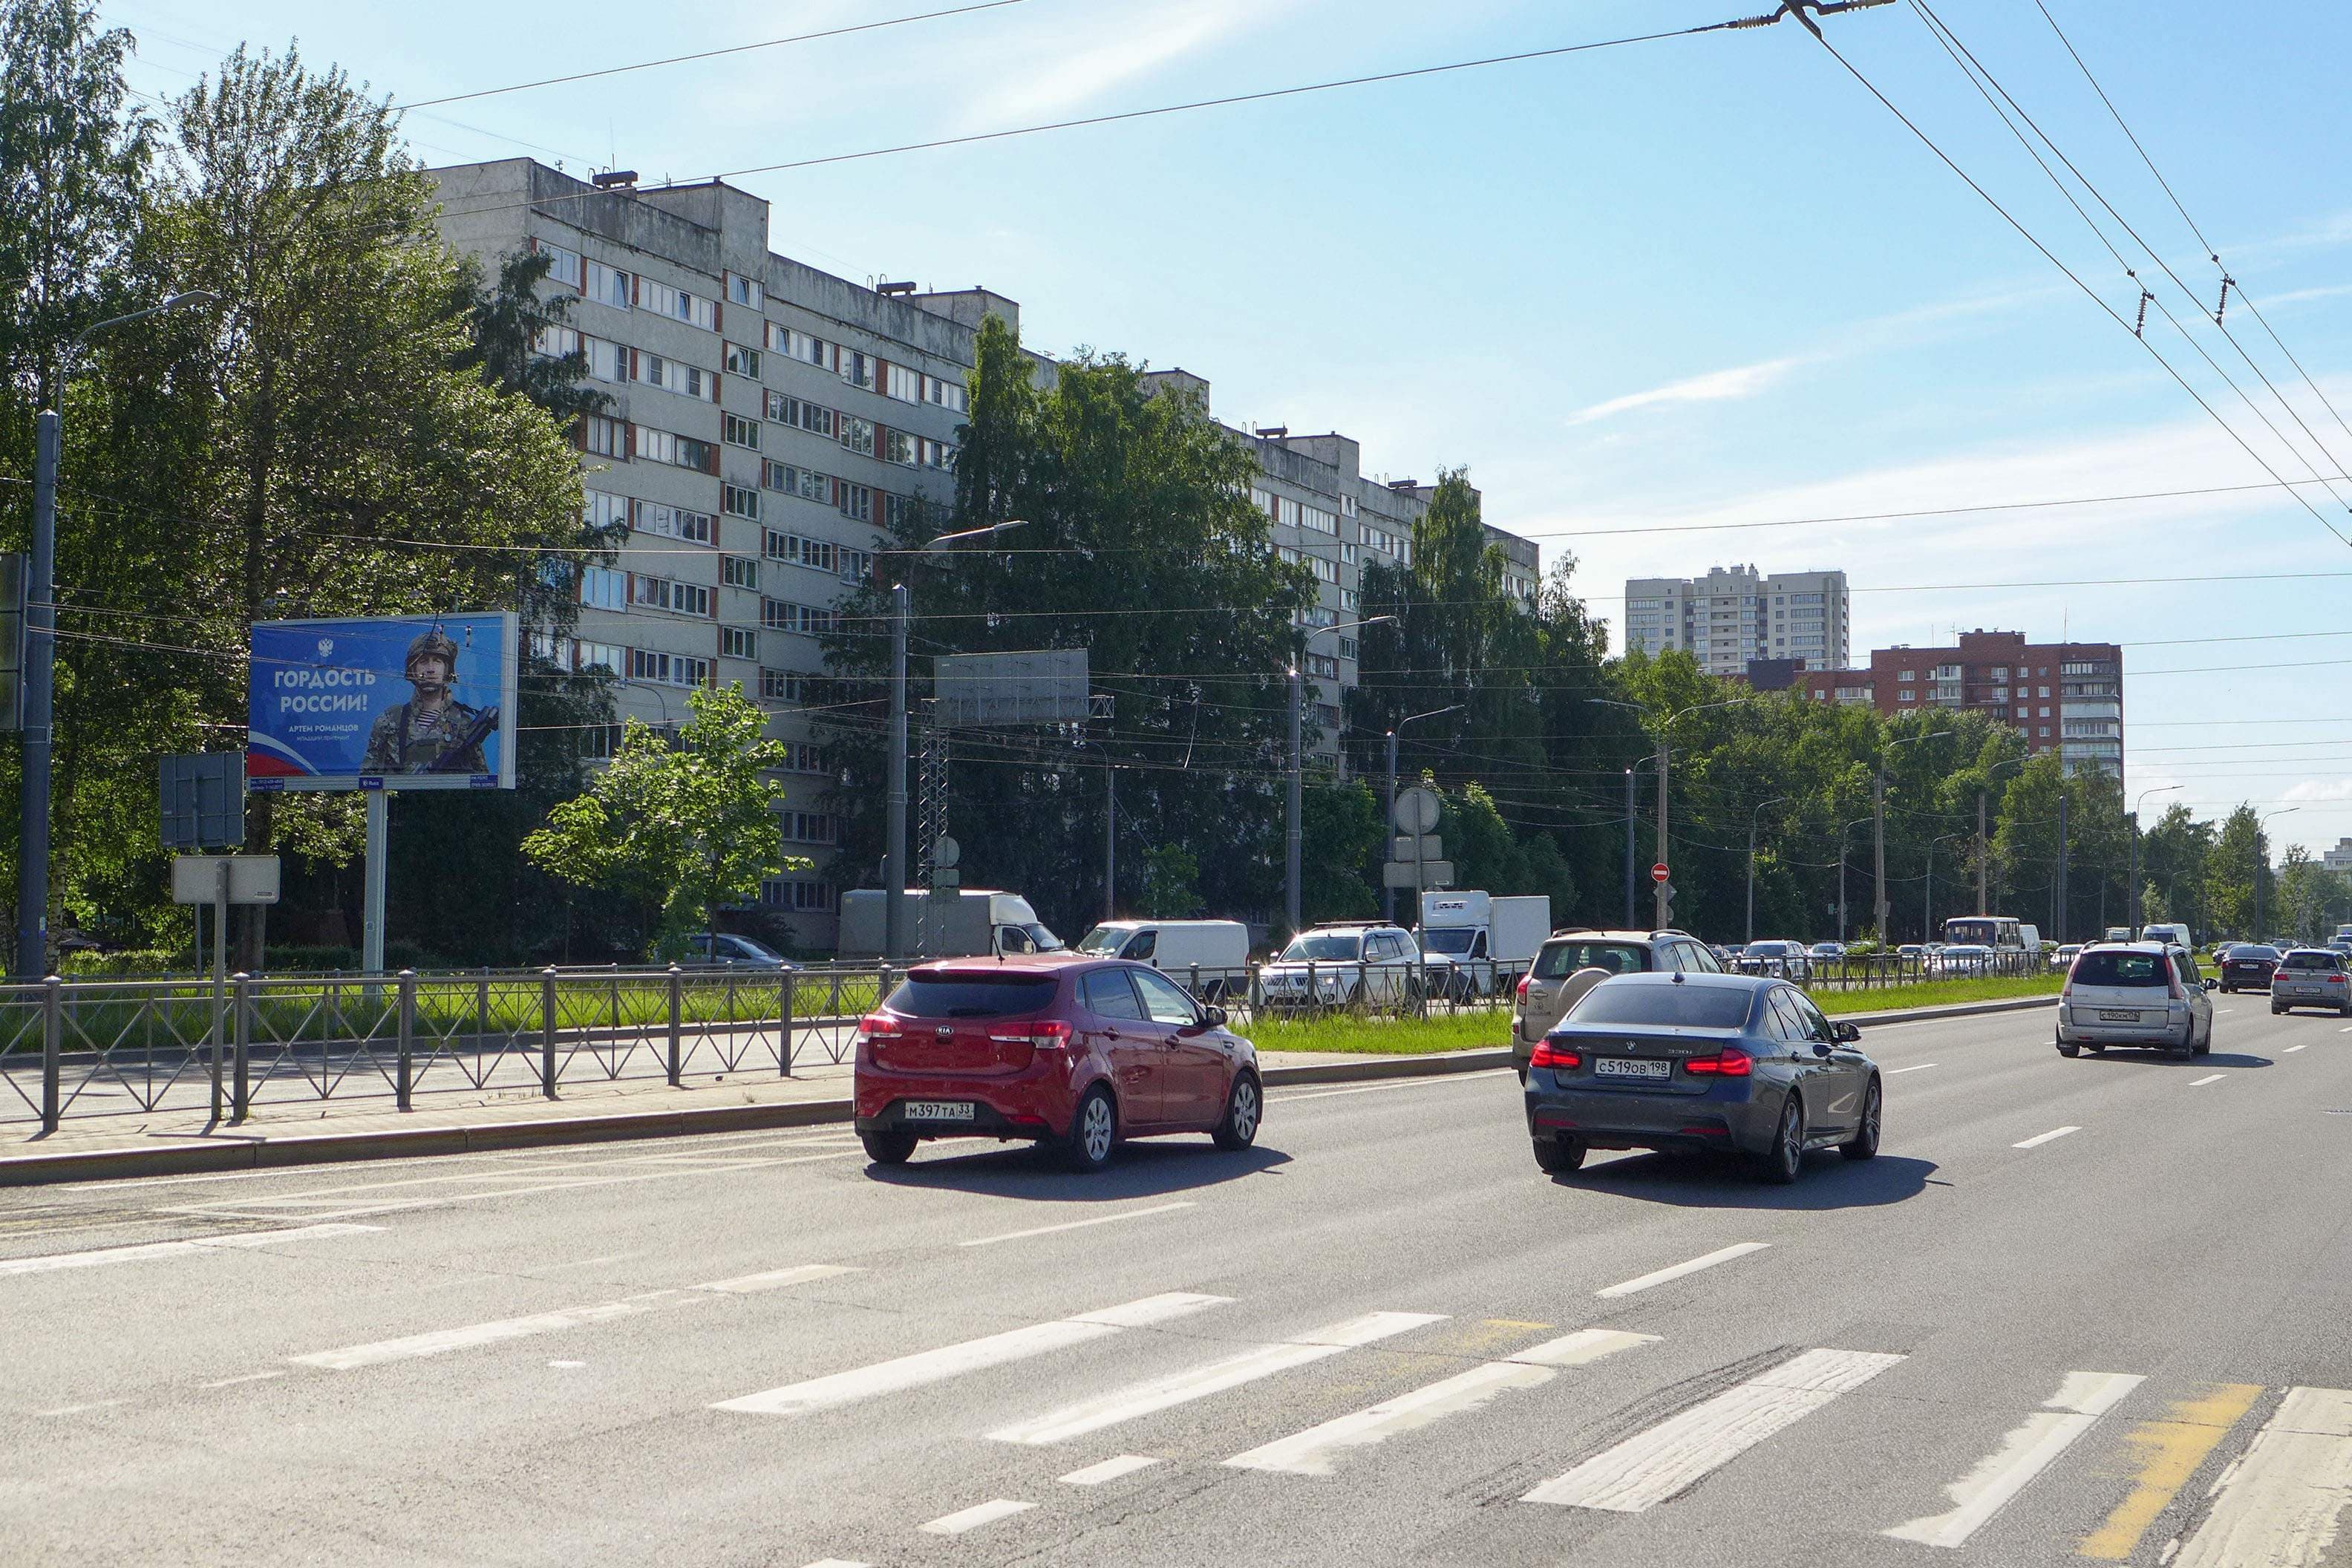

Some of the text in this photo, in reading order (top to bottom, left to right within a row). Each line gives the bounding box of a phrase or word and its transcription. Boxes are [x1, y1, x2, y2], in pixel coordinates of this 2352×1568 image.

[275, 670, 376, 689] ГОРДОСТЬ
[281, 694, 368, 713] РОССИИ!
[288, 724, 359, 733] АРТЕМ РОМАНЦОВ
